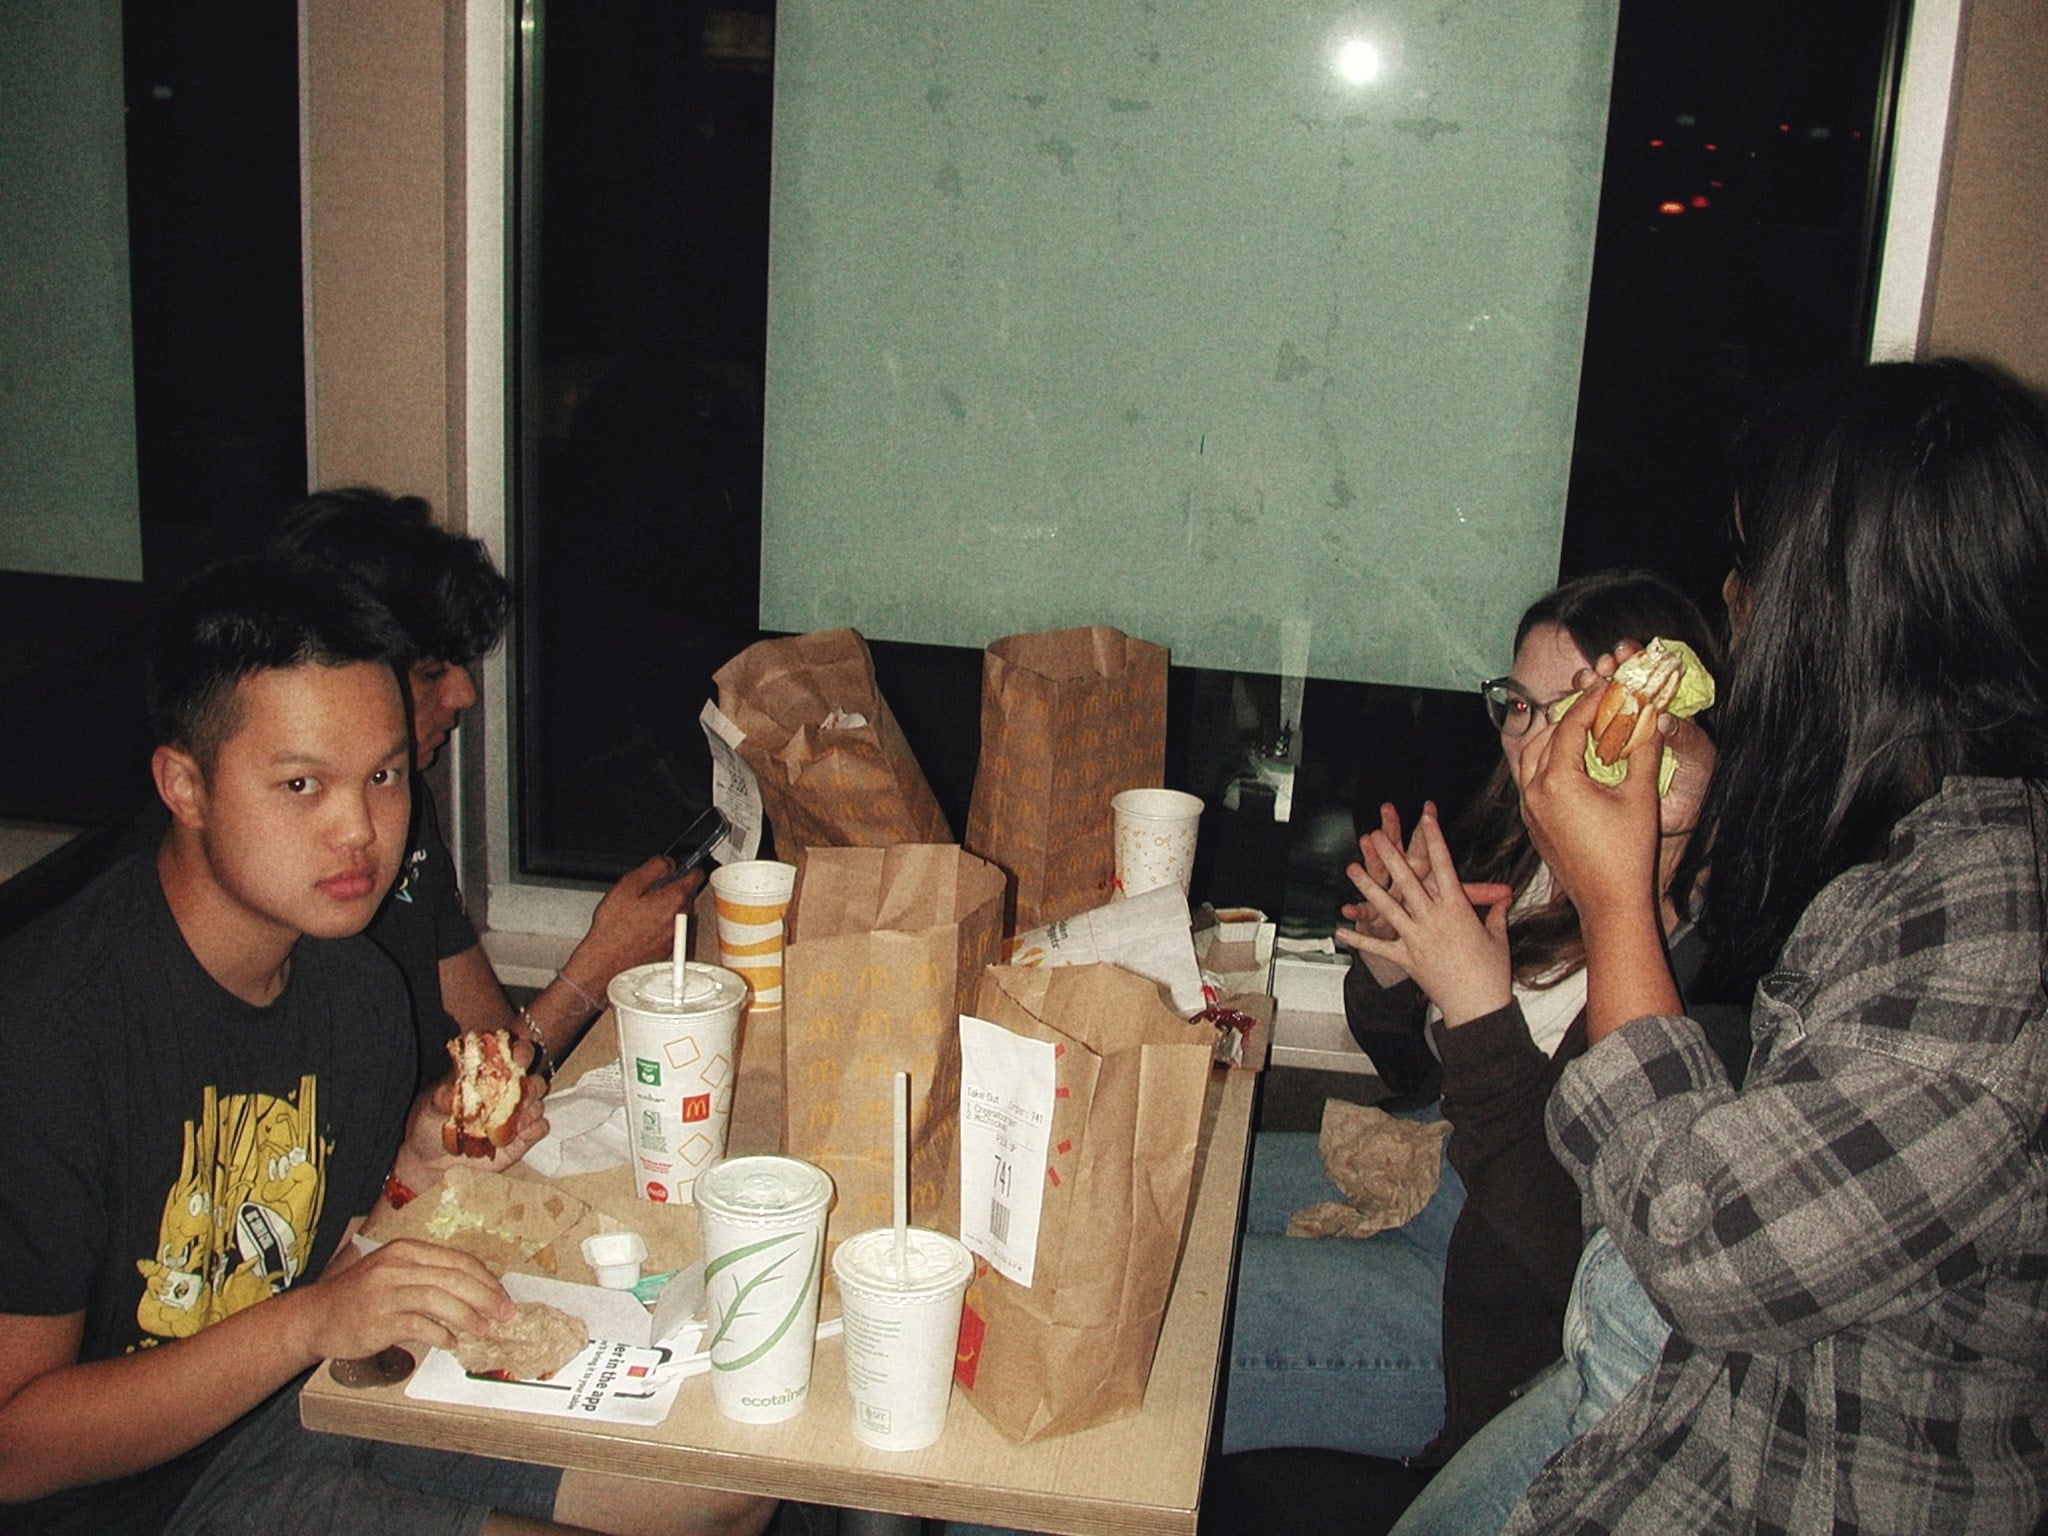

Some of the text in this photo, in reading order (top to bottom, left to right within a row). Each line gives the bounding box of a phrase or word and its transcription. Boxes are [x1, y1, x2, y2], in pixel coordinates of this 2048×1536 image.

[994, 1154, 1012, 1198] 741
[605, 1357, 625, 1369] in
[596, 1370, 616, 1389] the
[581, 1390, 604, 1413] app
